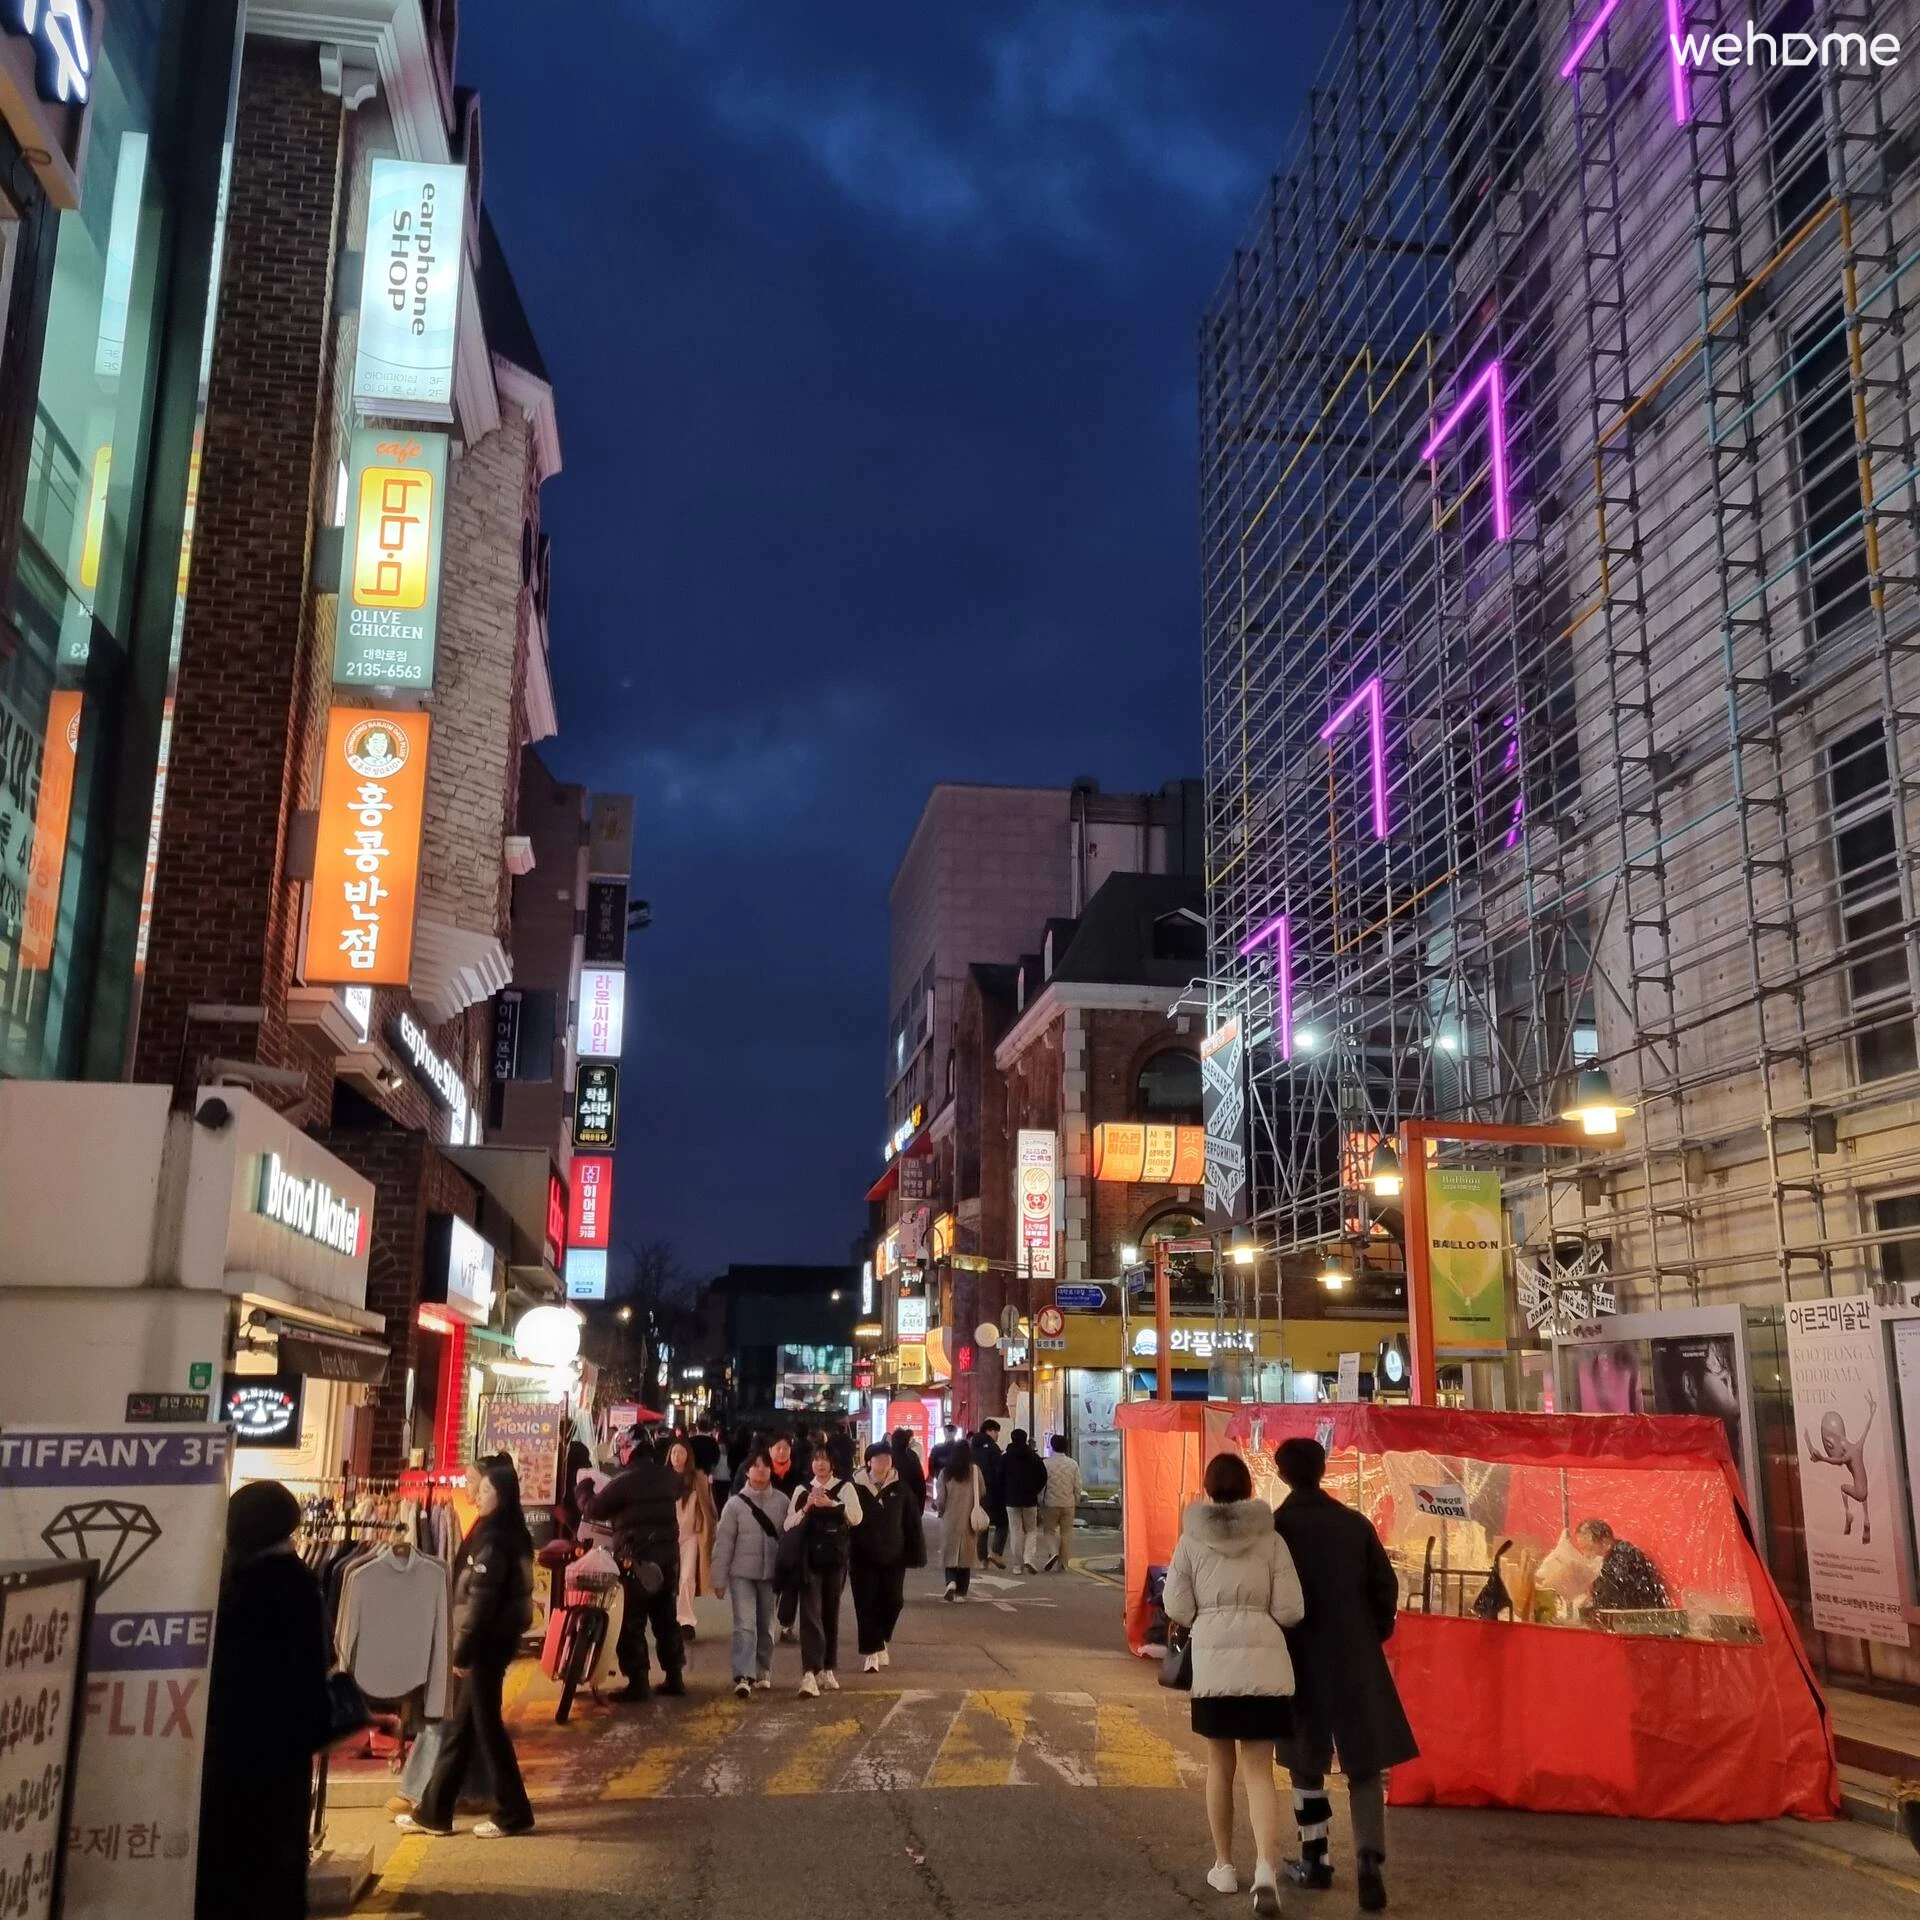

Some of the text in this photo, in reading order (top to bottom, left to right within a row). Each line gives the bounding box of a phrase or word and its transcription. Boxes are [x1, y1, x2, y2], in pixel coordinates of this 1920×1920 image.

[387, 209, 412, 312] SHOP
[411, 182, 436, 337] earphone
[375, 437, 424, 464] cafe
[350, 608, 402, 625] OLIVE
[349, 622, 424, 640] CHICKEN
[363, 648, 408, 663] 대학로점
[345, 662, 423, 680] 2135-6563
[338, 781, 394, 970] 홍콩반점
[579, 1100, 612, 1116] 스터디
[583, 1115, 608, 1130] 카페
[1182, 1132, 1202, 1144] 2F
[267, 1152, 360, 1257] Brand Market
[1789, 1299, 1871, 1335] 아르코미술관
[1795, 1366, 1862, 1383] ODORAMA
[1797, 1387, 1838, 1404] CITIES
[0, 1437, 228, 1468] TIFFANY 3F
[109, 1617, 208, 1648] CAFE
